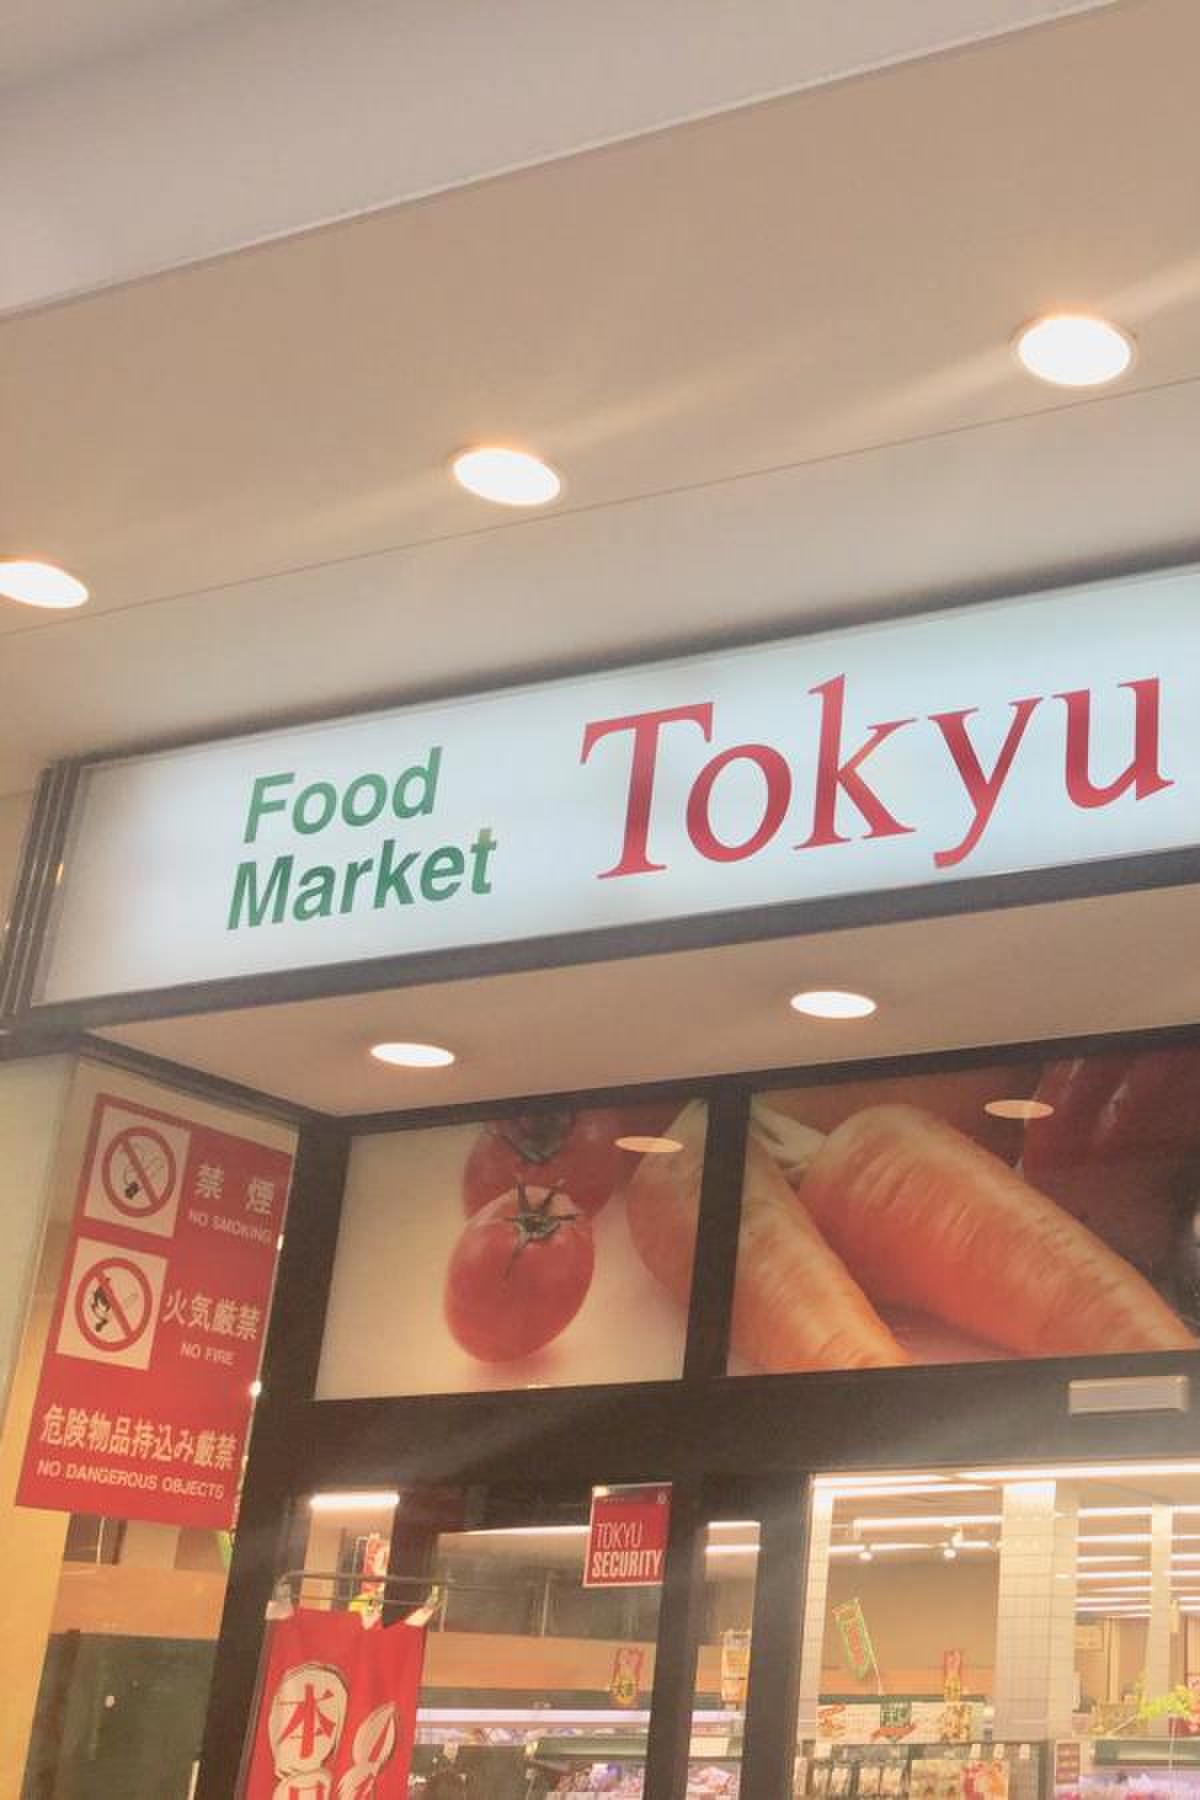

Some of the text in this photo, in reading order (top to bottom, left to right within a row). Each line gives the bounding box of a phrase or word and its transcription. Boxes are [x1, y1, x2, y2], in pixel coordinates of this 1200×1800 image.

[244, 746, 443, 844] Food
[580, 673, 1175, 880] Tokyu
[226, 828, 497, 931] Market
[195, 1163, 275, 1216] 禁煙
[188, 1209, 274, 1245] NO SMOKING
[162, 1288, 261, 1341] 火気厳禁
[180, 1342, 236, 1366] NO FIRE
[40, 1402, 238, 1471] 危険物品持込み厳禁
[36, 1459, 225, 1500] NO DANGEROUS OBJECTS
[596, 1521, 644, 1549] TOKYU
[591, 1548, 664, 1579] SECURITY
